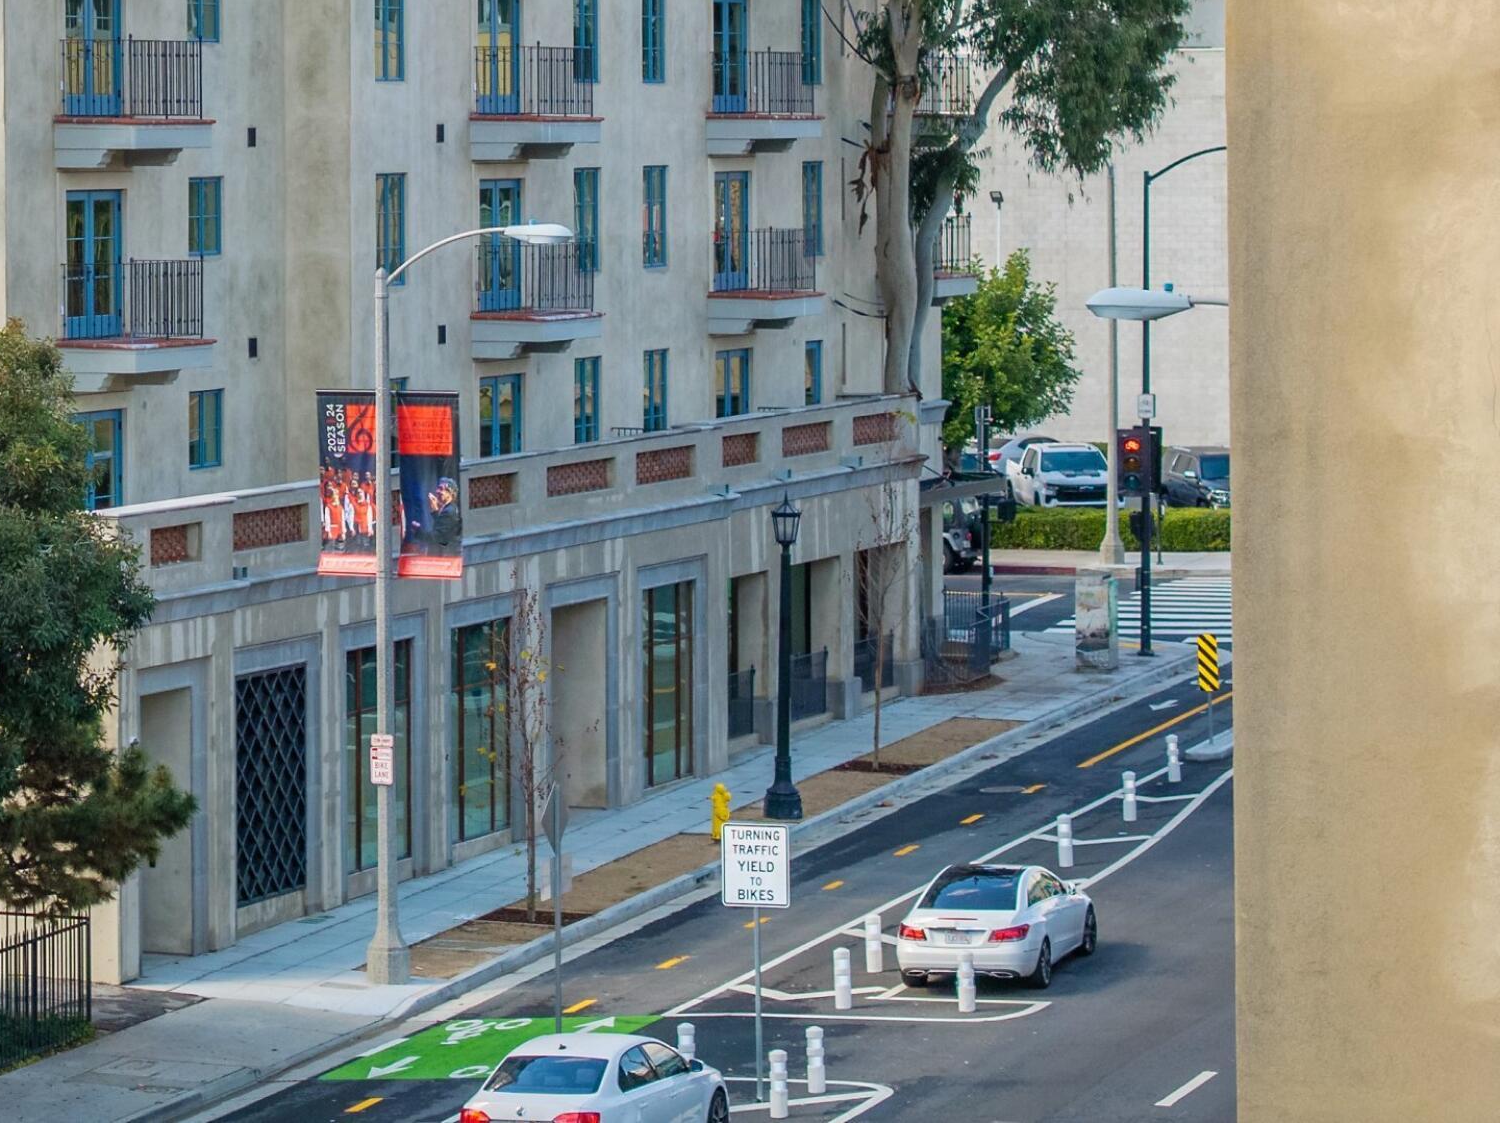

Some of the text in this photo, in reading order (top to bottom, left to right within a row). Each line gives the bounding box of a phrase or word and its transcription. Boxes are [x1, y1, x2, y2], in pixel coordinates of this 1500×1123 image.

[326, 403, 337, 453] 2023 24
[336, 404, 346, 453] SEASON
[374, 771, 389, 779] LANE
[731, 829, 780, 841] TURNING
[733, 844, 779, 856] TRAFFIC
[737, 860, 775, 873] YIELD
[750, 876, 763, 886] TO
[738, 889, 775, 901] BIKES
